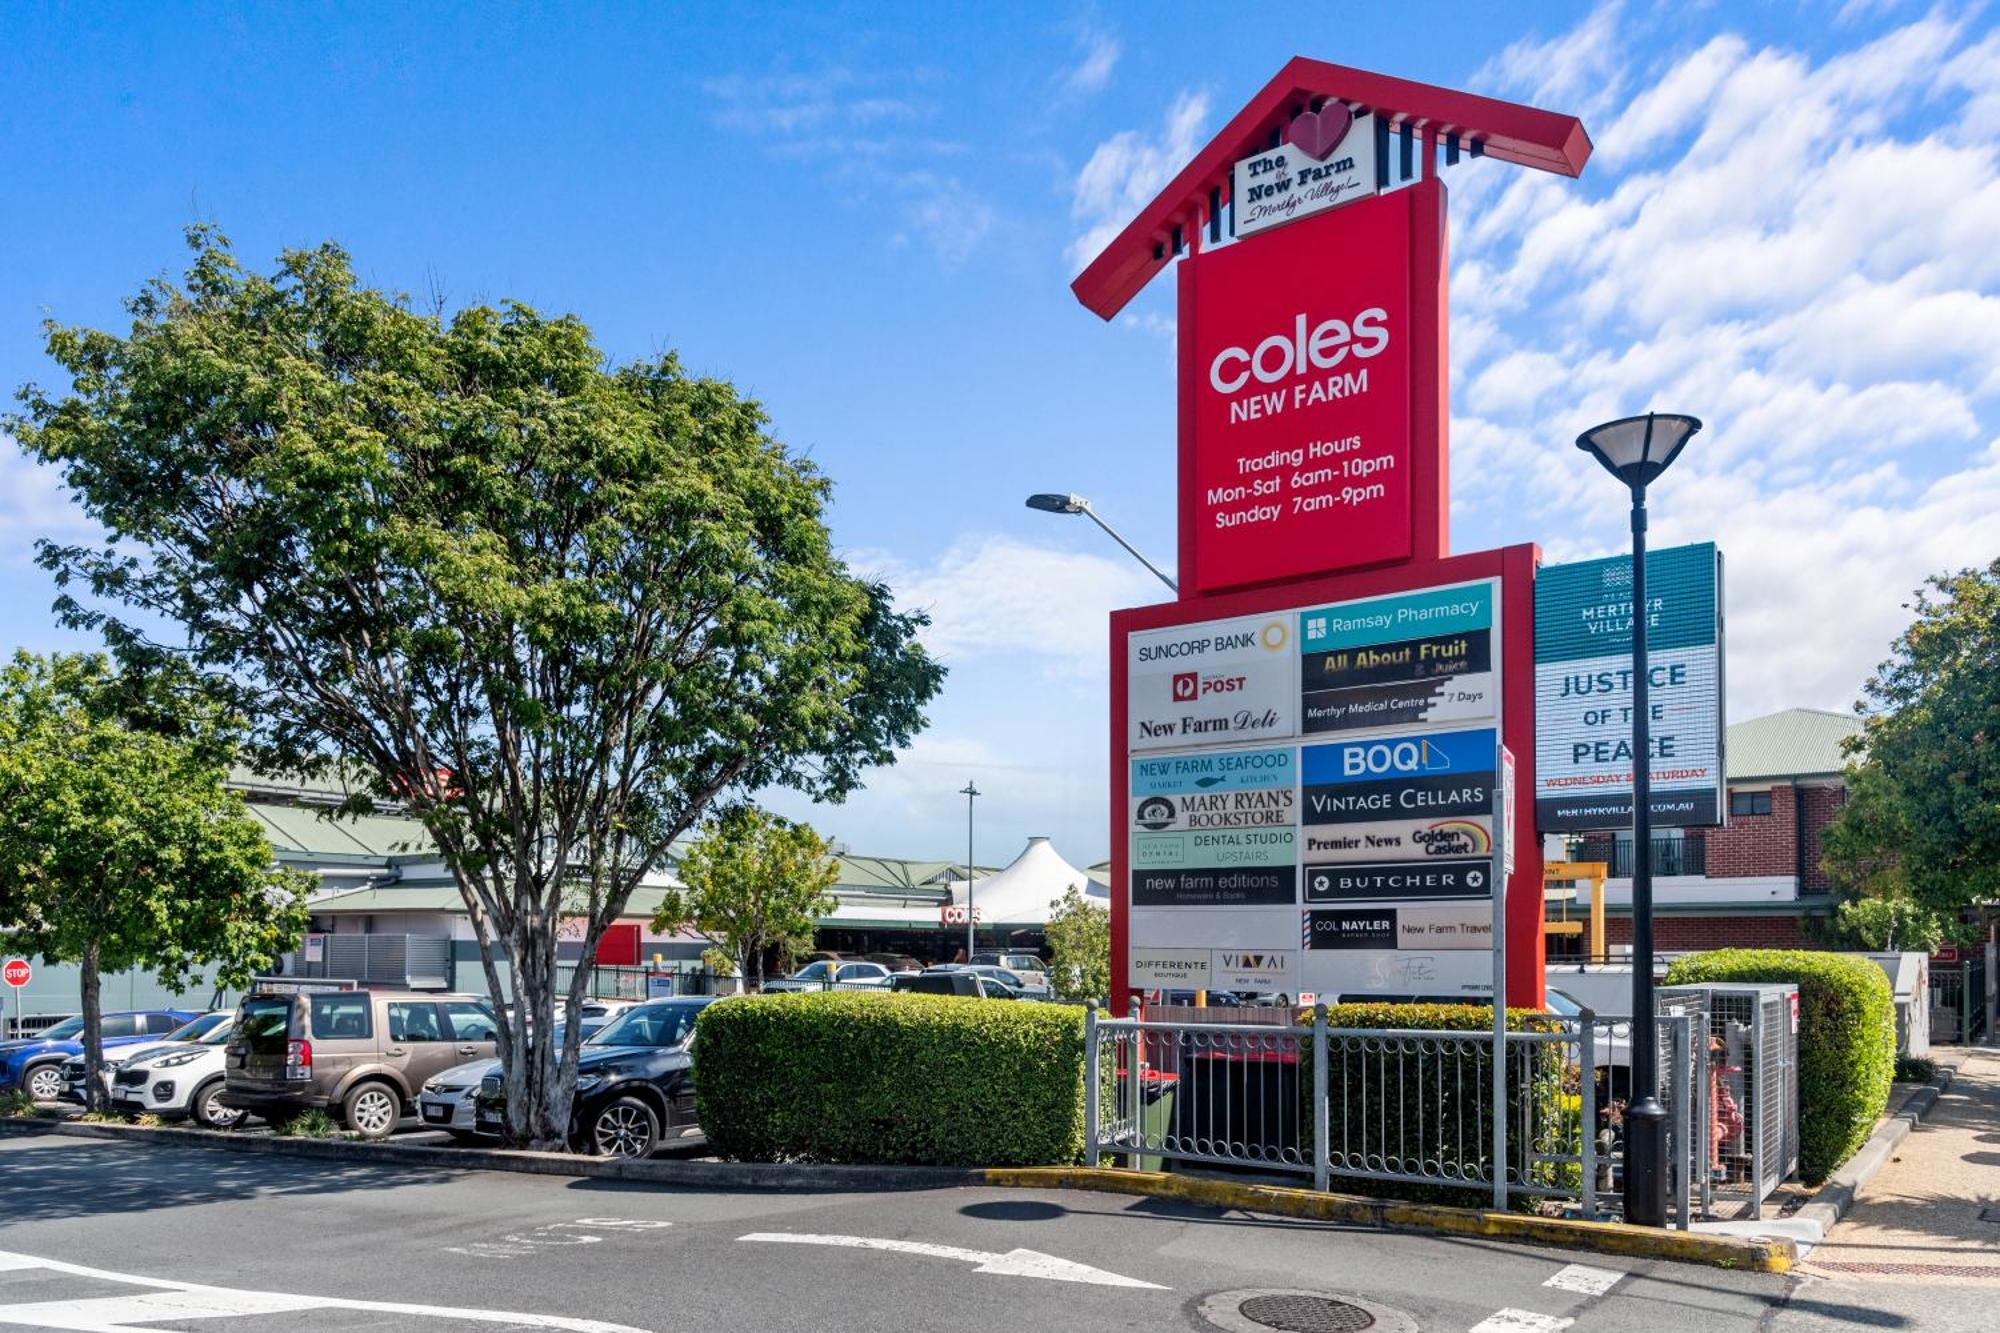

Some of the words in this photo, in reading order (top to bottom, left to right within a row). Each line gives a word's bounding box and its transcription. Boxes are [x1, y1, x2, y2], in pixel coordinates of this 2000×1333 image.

[1248, 155, 1285, 178] The
[1248, 178, 1292, 203] New
[1298, 156, 1355, 186] Farm
[1209, 307, 1389, 394] coles
[1230, 389, 1286, 424] NEW
[1294, 368, 1368, 409] FARM
[1237, 448, 1303, 474] Trading
[1309, 435, 1361, 459] Hours
[1207, 476, 1281, 506] Mon-Sat
[1290, 454, 1395, 488] 6am-10pm
[1215, 504, 1282, 528] Sunday
[1292, 483, 1385, 514] 7am-9pm
[1332, 614, 1393, 634] Ramsay
[1398, 600, 1480, 624] Pharmacy
[1587, 614, 1660, 634] VILLAE
[1139, 638, 1211, 662] SUNCORP
[1215, 632, 1256, 652] BANK
[1324, 655, 1348, 672] All
[1356, 647, 1410, 668] About
[1419, 639, 1469, 661] Fruit
[1202, 676, 1247, 695] POST
[1560, 663, 1686, 697] JUSTCE
[1448, 693, 1455, 703] 7
[1458, 691, 1483, 703] Days
[1307, 706, 1346, 720] Merthyr
[1349, 701, 1387, 714] Medical
[1390, 698, 1425, 711] Centre
[1583, 709, 1612, 726] OF
[1619, 704, 1664, 723] TE
[1139, 720, 1176, 739] New
[1181, 716, 1229, 735] Farm
[1233, 708, 1279, 732] Deli
[1140, 763, 1170, 777] NEW
[1175, 758, 1213, 775] FARM
[1217, 753, 1288, 772] SEAFOOD
[1343, 742, 1418, 776] BOQ
[1150, 780, 1183, 790] MARKET
[1240, 774, 1278, 784] KITCHEN
[1545, 773, 1622, 788] WEDNESDAY
[1647, 768, 1708, 780] ATURDAY
[1181, 793, 1230, 813] MARY
[1234, 789, 1293, 810] RYAN'S
[1311, 793, 1392, 814] VINTAGE
[1400, 787, 1484, 809] CELLARS
[1189, 810, 1285, 828] BOOKSTORE
[1194, 835, 1242, 847] DENTAL
[1245, 832, 1294, 845] STUDIO
[1307, 836, 1361, 851] Premier
[1365, 834, 1401, 848] News
[1412, 828, 1460, 844] Golden
[1216, 850, 1269, 863] UPSTAIRS
[1425, 841, 1470, 856] Casket
[1146, 877, 1176, 890] new
[1180, 873, 1214, 890] farm
[1218, 873, 1280, 889] editions
[1339, 873, 1455, 889] BUTCHER
[1315, 920, 1339, 931] COL
[1342, 920, 1390, 930] NAYLER
[1402, 923, 1424, 934] New
[1428, 923, 1456, 934] Farm
[1458, 922, 1492, 934] Travel
[6, 969, 29, 978] STOP
[1135, 960, 1207, 970] DIFFERENTE
